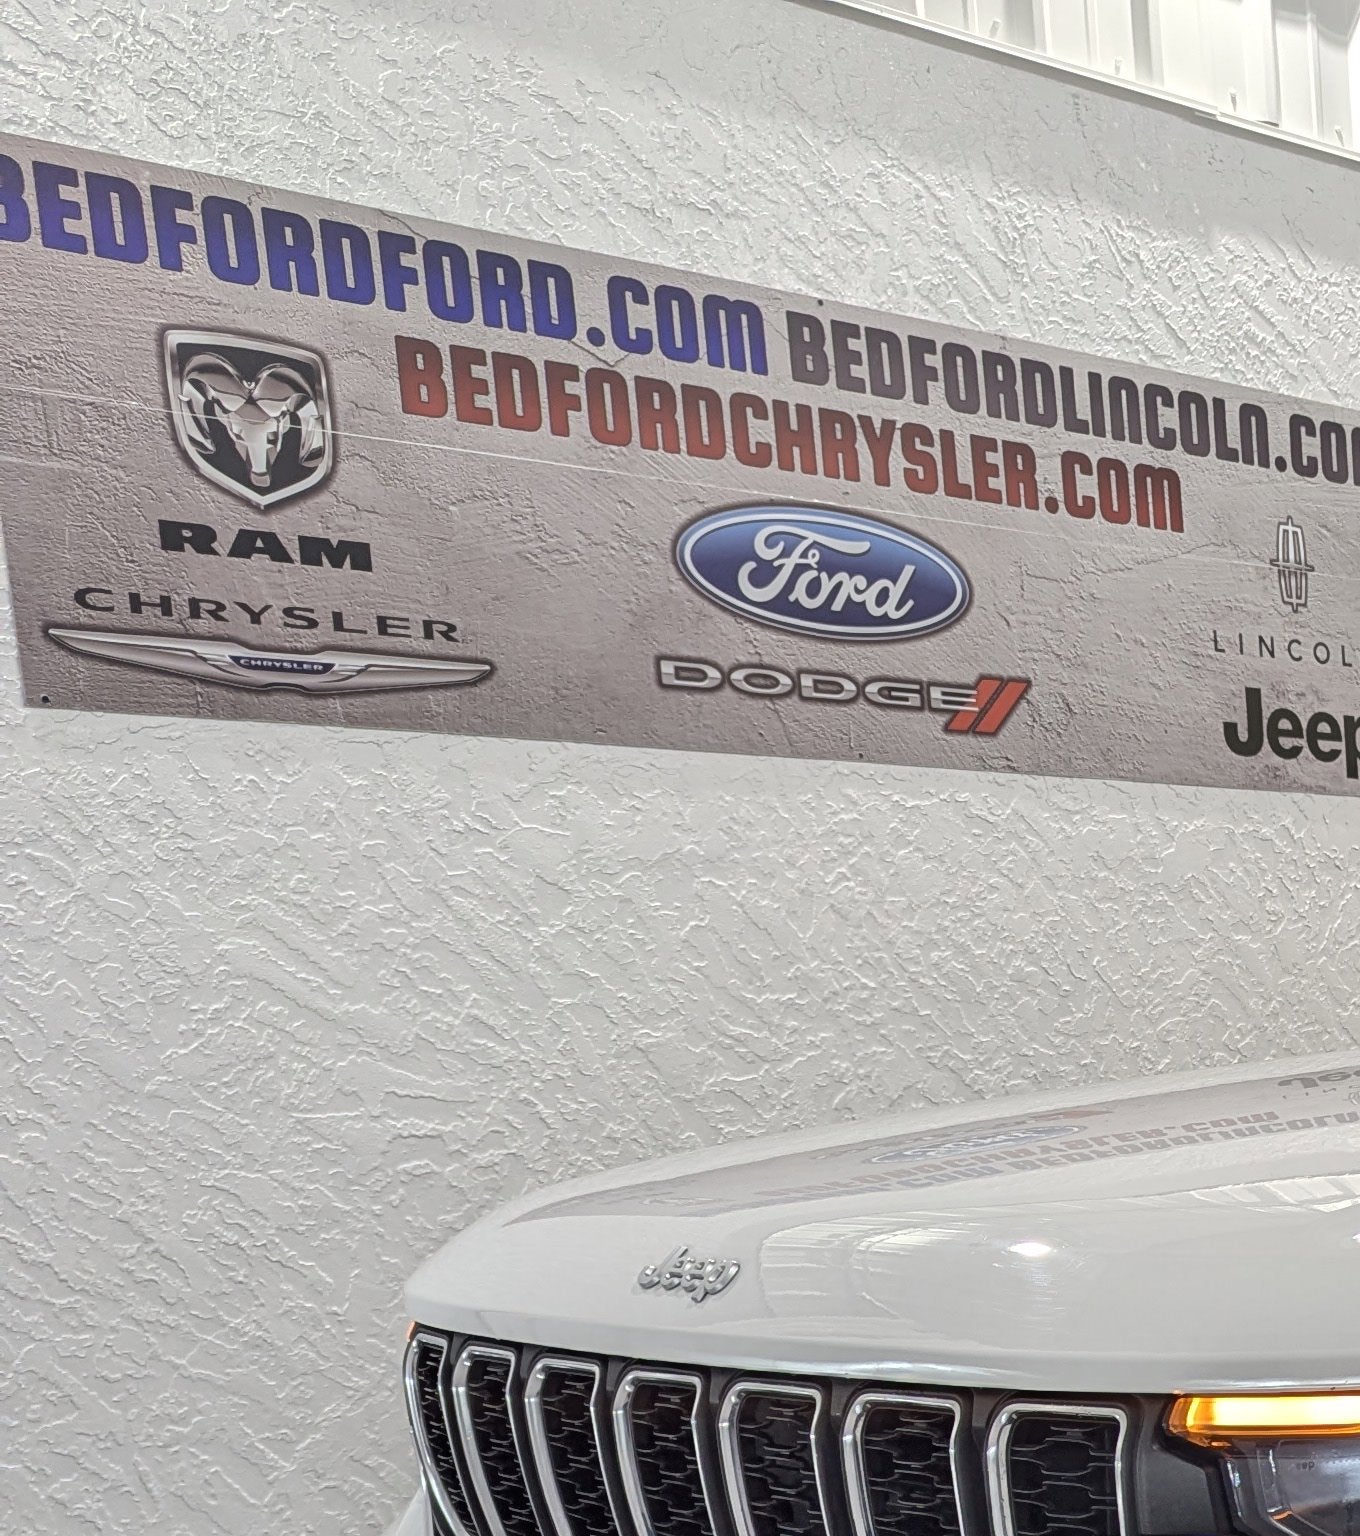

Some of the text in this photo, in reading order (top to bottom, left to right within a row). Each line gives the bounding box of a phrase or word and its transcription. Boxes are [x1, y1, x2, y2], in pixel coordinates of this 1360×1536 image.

[395, 335, 1185, 533] BEDFORDCHRYSLER.COM
[158, 519, 373, 572] RAM
[738, 527, 916, 621] Ford
[73, 587, 460, 643] CHRYSLER
[240, 659, 324, 671] CHRYSLER
[659, 658, 978, 711] DODGE
[638, 1246, 740, 1303] Jeep
